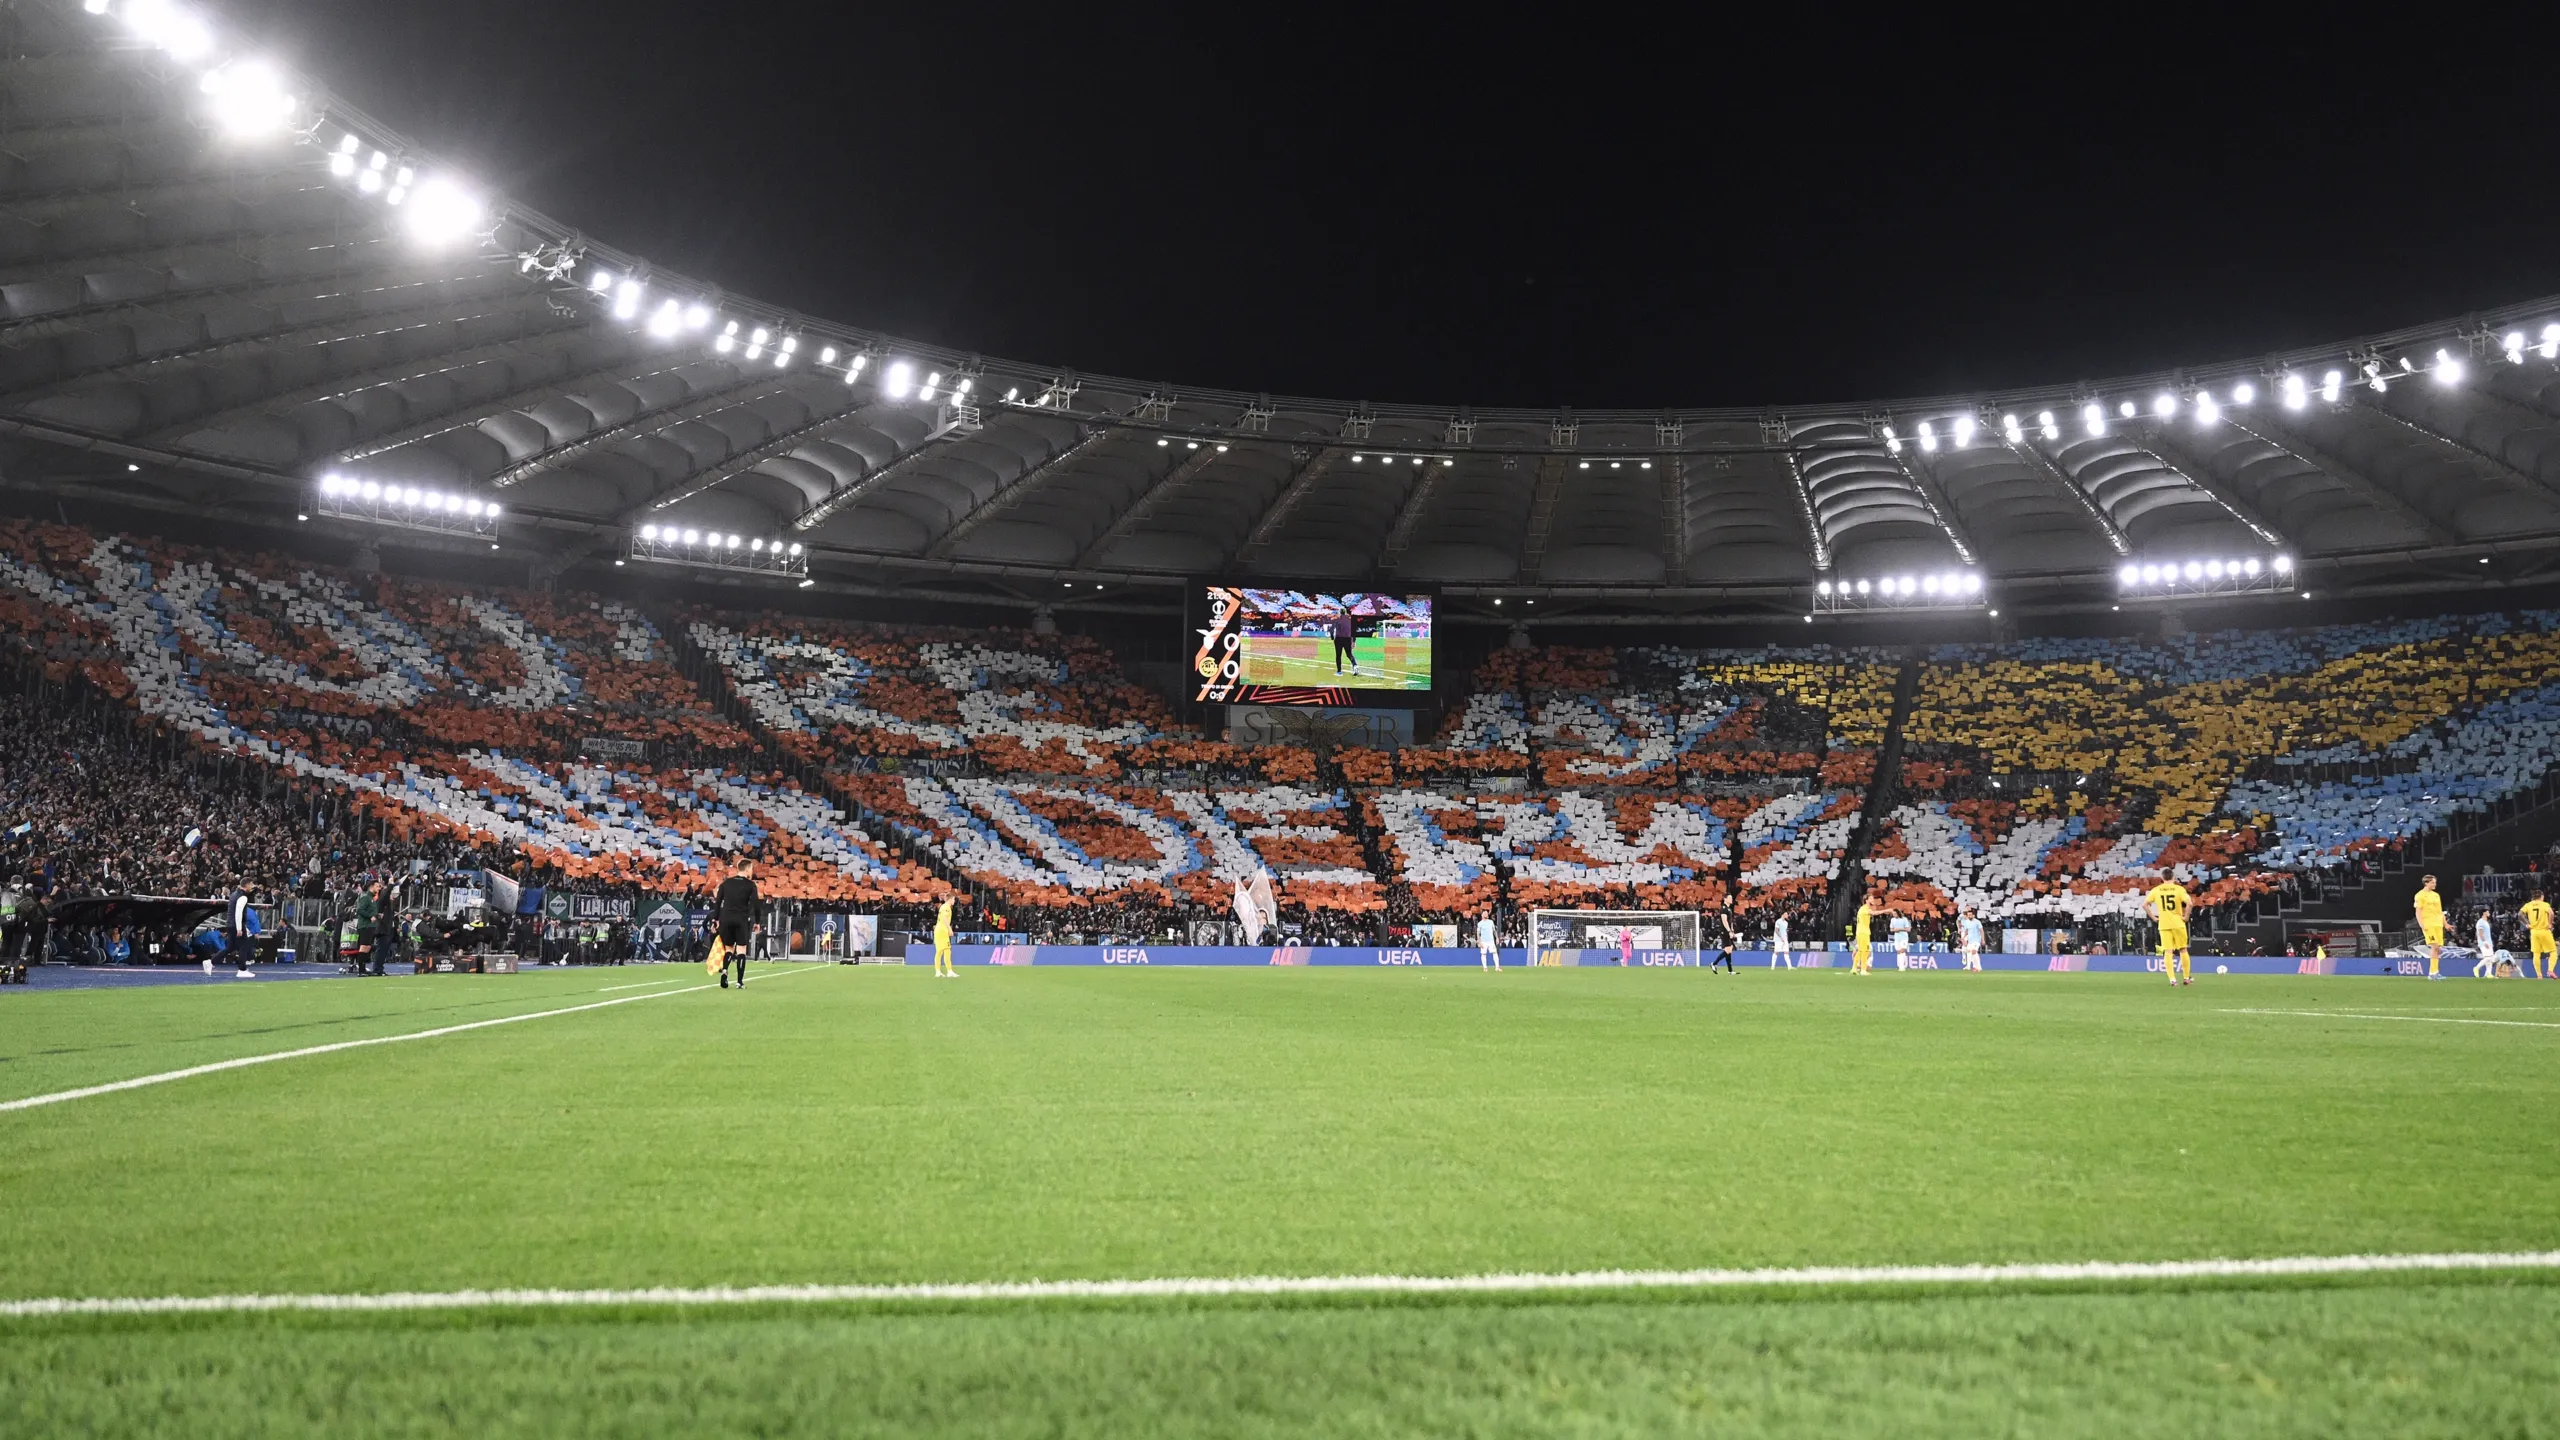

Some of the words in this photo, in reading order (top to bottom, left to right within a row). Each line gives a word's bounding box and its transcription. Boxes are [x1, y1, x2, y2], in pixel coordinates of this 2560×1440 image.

[1223, 633, 1240, 651] 0
[1223, 660, 1239, 679] 0
[2160, 894, 2176, 911] 15
[2532, 908, 2539, 921] 7
[1103, 949, 1149, 964] UEFA
[1378, 950, 1422, 965] UEFA
[1642, 953, 1684, 966] UEFA
[1897, 956, 1938, 969] UEFA
[2397, 961, 2424, 975] UEFA
